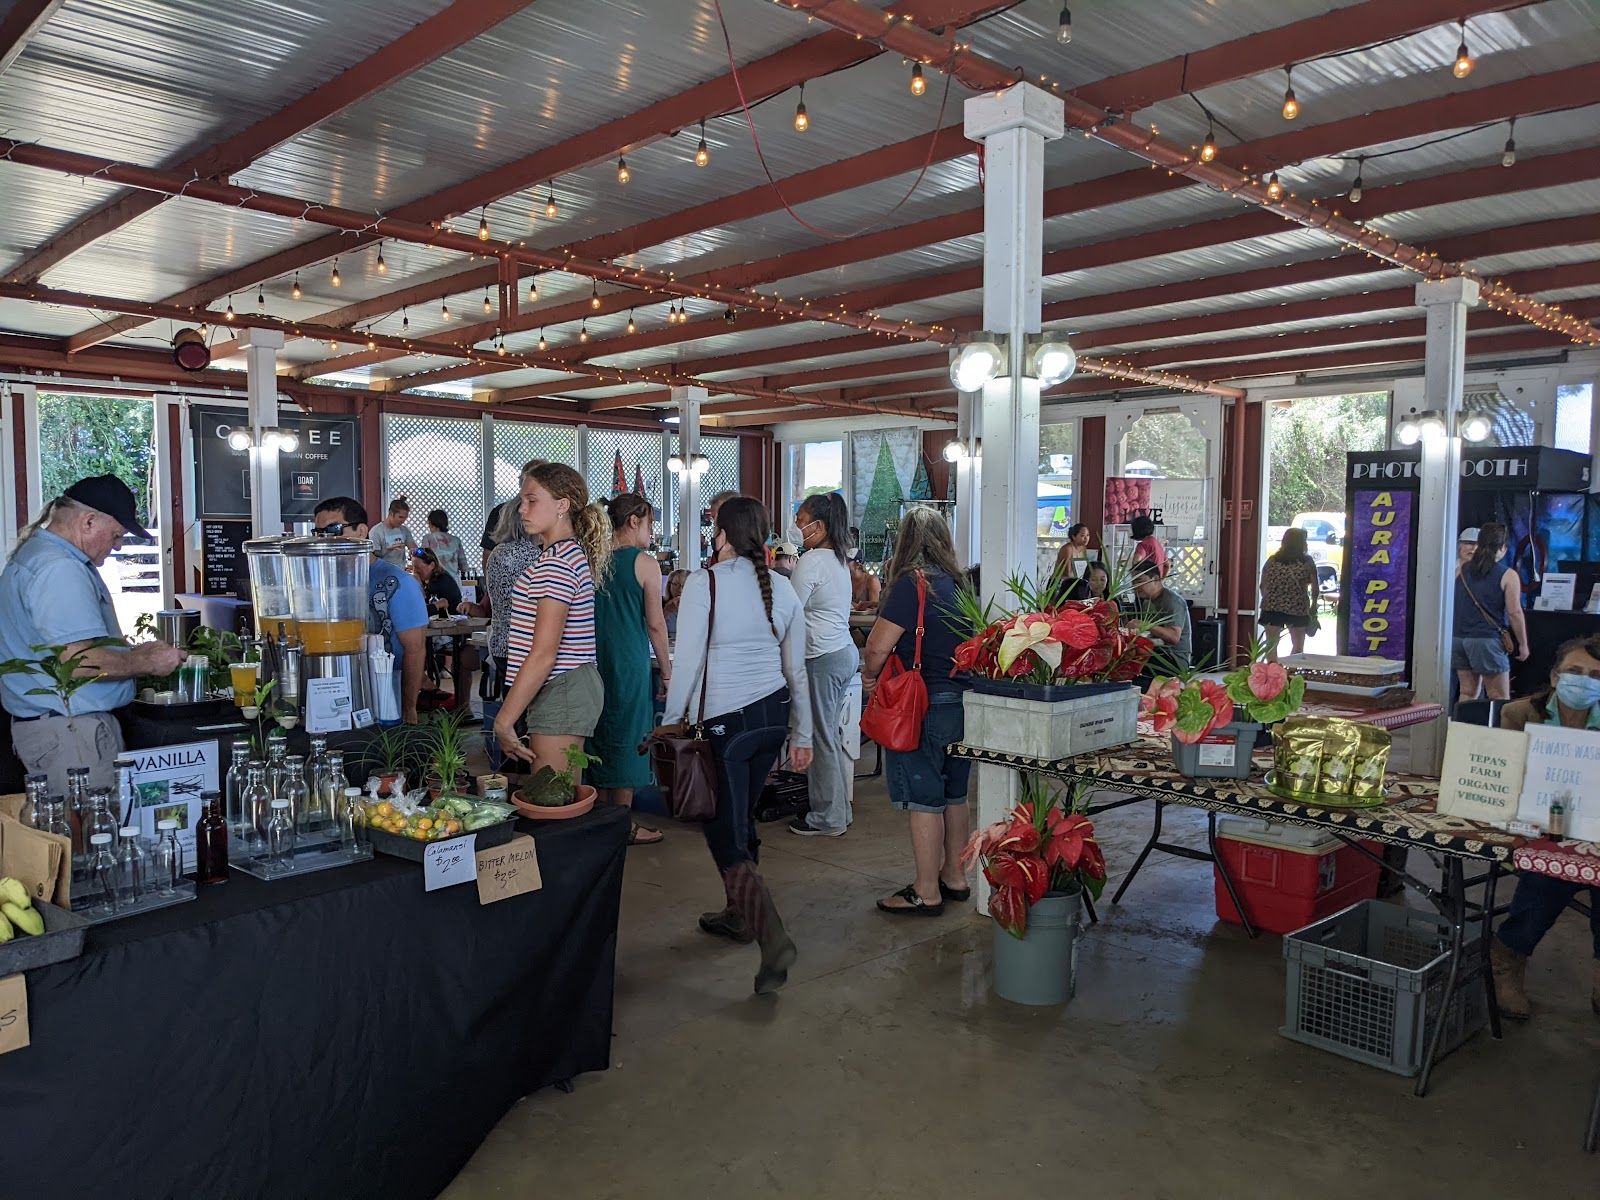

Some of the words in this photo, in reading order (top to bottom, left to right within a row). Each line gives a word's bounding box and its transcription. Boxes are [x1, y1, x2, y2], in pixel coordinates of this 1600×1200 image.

[215, 424, 342, 446] CEE
[1460, 457, 1528, 478] OOTH
[1367, 491, 1396, 564] AURA
[1362, 580, 1391, 659] PHOT
[134, 750, 206, 771] VANILLA
[1469, 752, 1508, 767] TEPA'S
[1470, 766, 1502, 779] FARM
[1545, 766, 1582, 786] BEFORE
[1458, 777, 1510, 795] ORGANIC
[426, 840, 468, 857] Calamansi
[478, 856, 507, 872] BITTER
[508, 849, 535, 864] MELON
